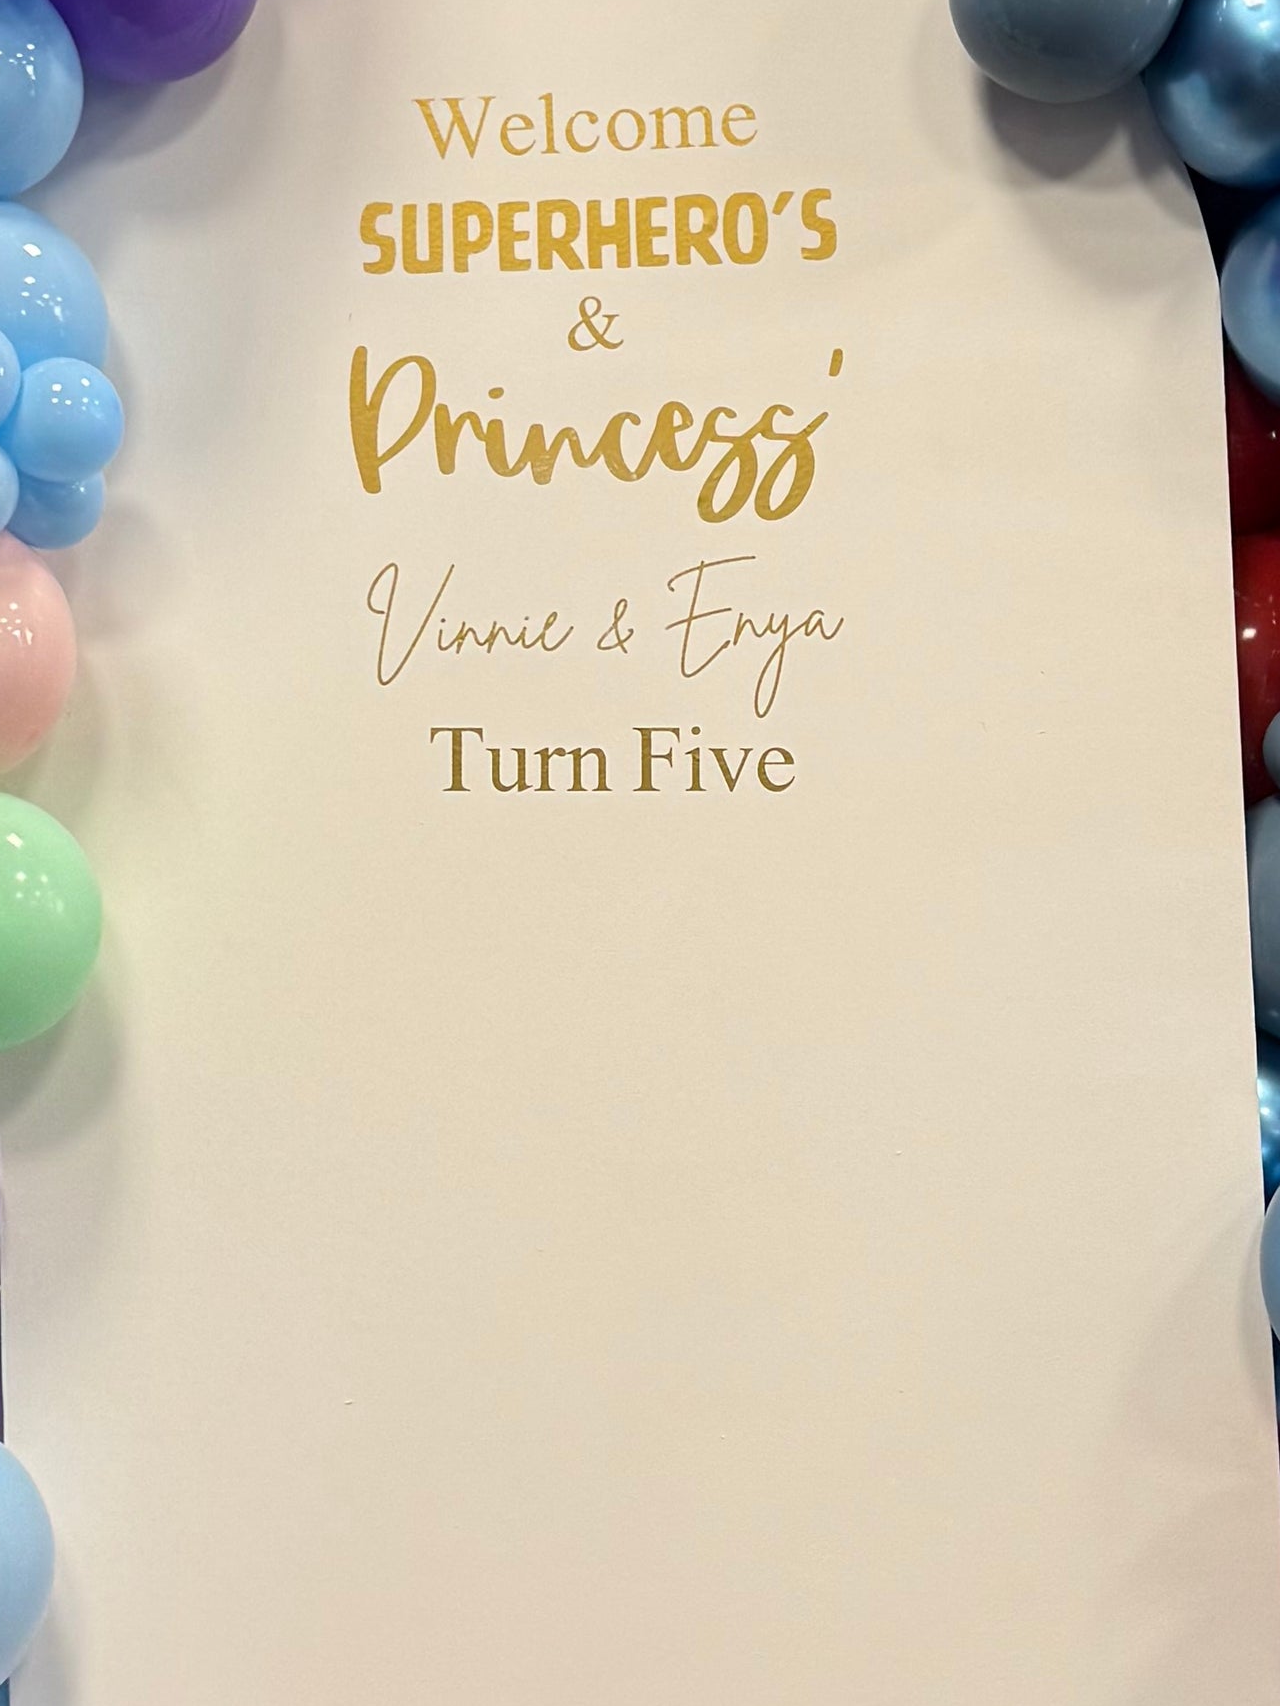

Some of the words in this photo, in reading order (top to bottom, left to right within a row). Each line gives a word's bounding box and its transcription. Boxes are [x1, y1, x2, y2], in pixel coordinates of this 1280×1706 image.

[413, 92, 758, 160] Welcome
[358, 187, 838, 275] SUPERHERO'S
[566, 295, 624, 352] &
[348, 345, 844, 524] Princess'
[366, 561, 574, 687] Vinnie
[594, 597, 636, 654] &
[663, 554, 845, 720] Enya
[429, 725, 611, 794] Turn
[632, 724, 797, 794] Five
